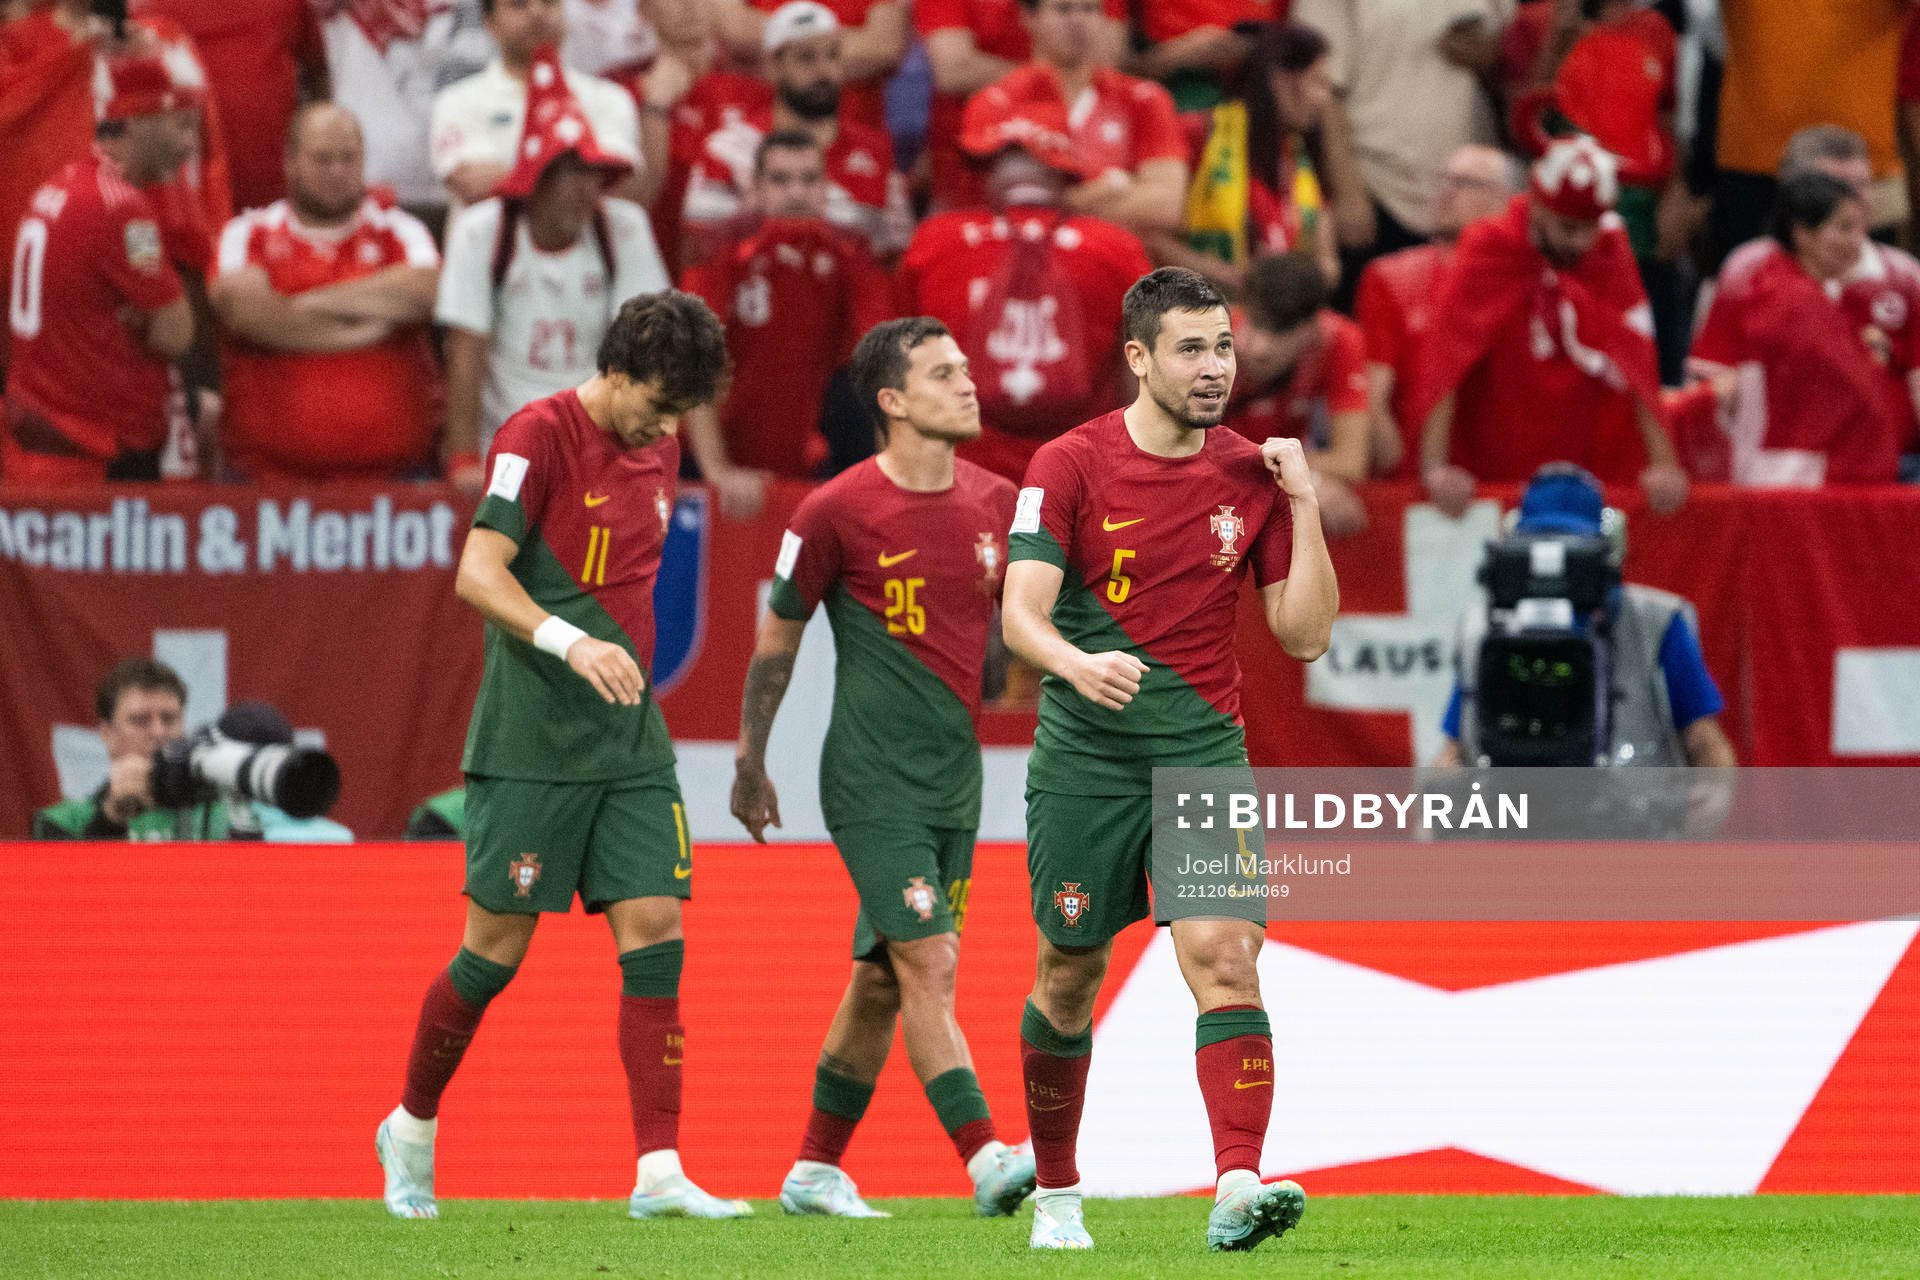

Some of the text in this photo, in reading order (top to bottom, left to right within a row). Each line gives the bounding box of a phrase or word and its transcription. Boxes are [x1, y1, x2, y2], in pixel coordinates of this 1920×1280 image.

[198, 505, 247, 573] &
[257, 495, 455, 572] Merlot
[581, 526, 610, 586] 11
[1106, 548, 1136, 604] 5
[884, 577, 926, 635] 25
